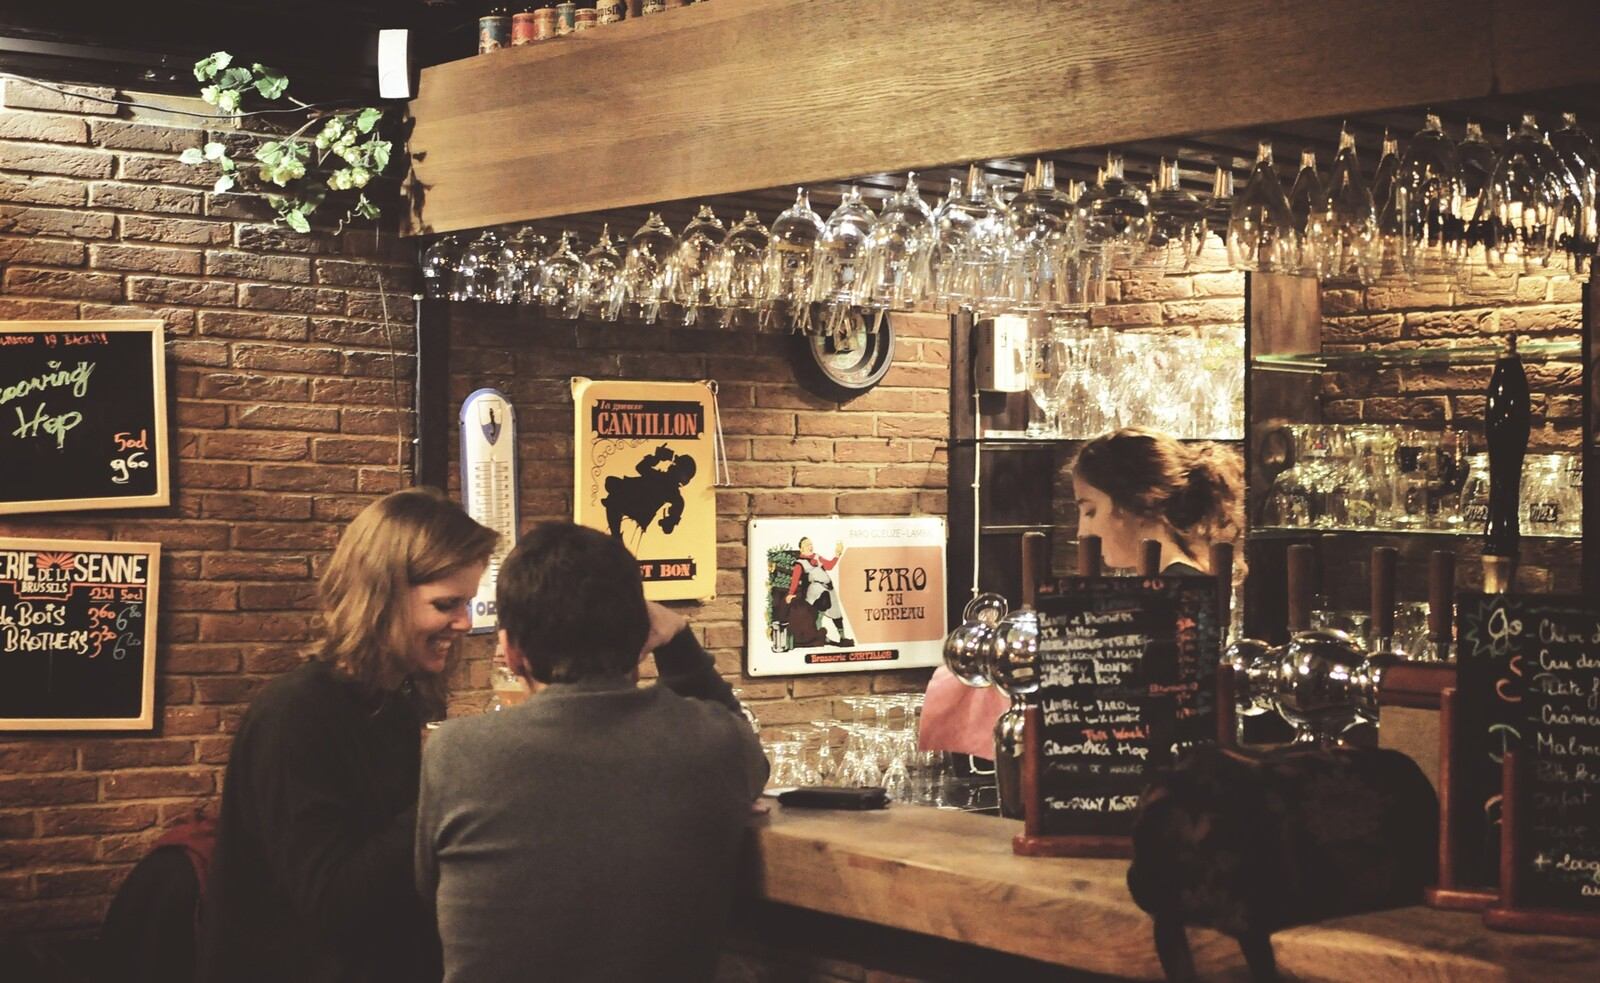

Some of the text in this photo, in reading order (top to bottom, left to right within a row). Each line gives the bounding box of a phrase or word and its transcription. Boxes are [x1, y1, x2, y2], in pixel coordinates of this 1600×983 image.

[12, 402, 83, 449] Hop
[598, 411, 698, 436] CANTILLON
[38, 568, 55, 582] DE
[55, 568, 71, 582] LA
[73, 554, 147, 584] SENNE
[659, 563, 691, 578] BON
[863, 567, 927, 592] FARO
[21, 582, 68, 594] BRUSSELS
[885, 593, 903, 606] AU
[864, 607, 925, 621] TONNEAU
[2, 625, 89, 655] BROTHERS
